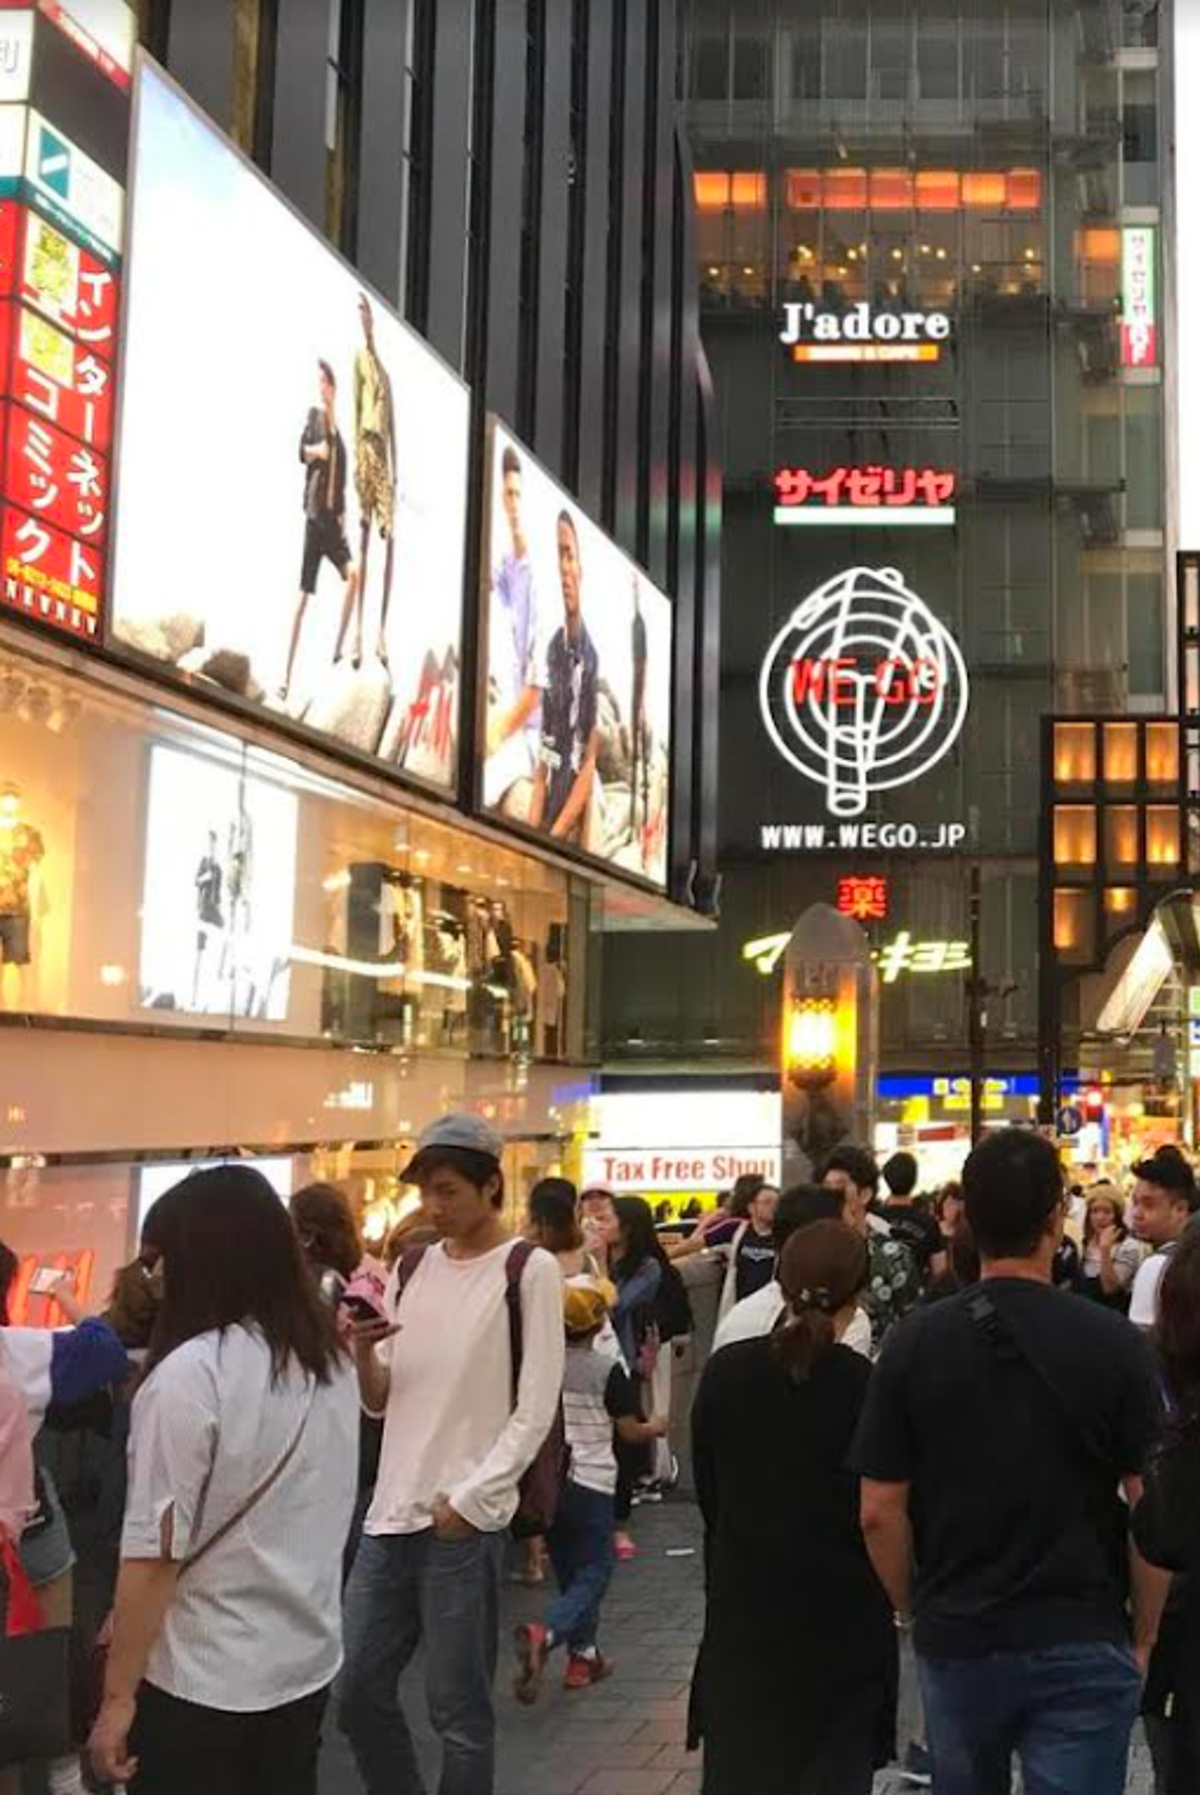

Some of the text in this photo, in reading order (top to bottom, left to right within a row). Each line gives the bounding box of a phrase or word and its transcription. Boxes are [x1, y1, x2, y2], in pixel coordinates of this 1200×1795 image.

[778, 301, 951, 344] J'adore
[66, 268, 112, 588] インターネット
[15, 365, 60, 563] コミック
[775, 466, 955, 506] サイゼリヤ
[761, 823, 966, 849] WWW.WEGO.JP
[838, 876, 887, 918] 薬
[604, 1157, 644, 1182] Tax
[651, 1157, 705, 1180] Free
